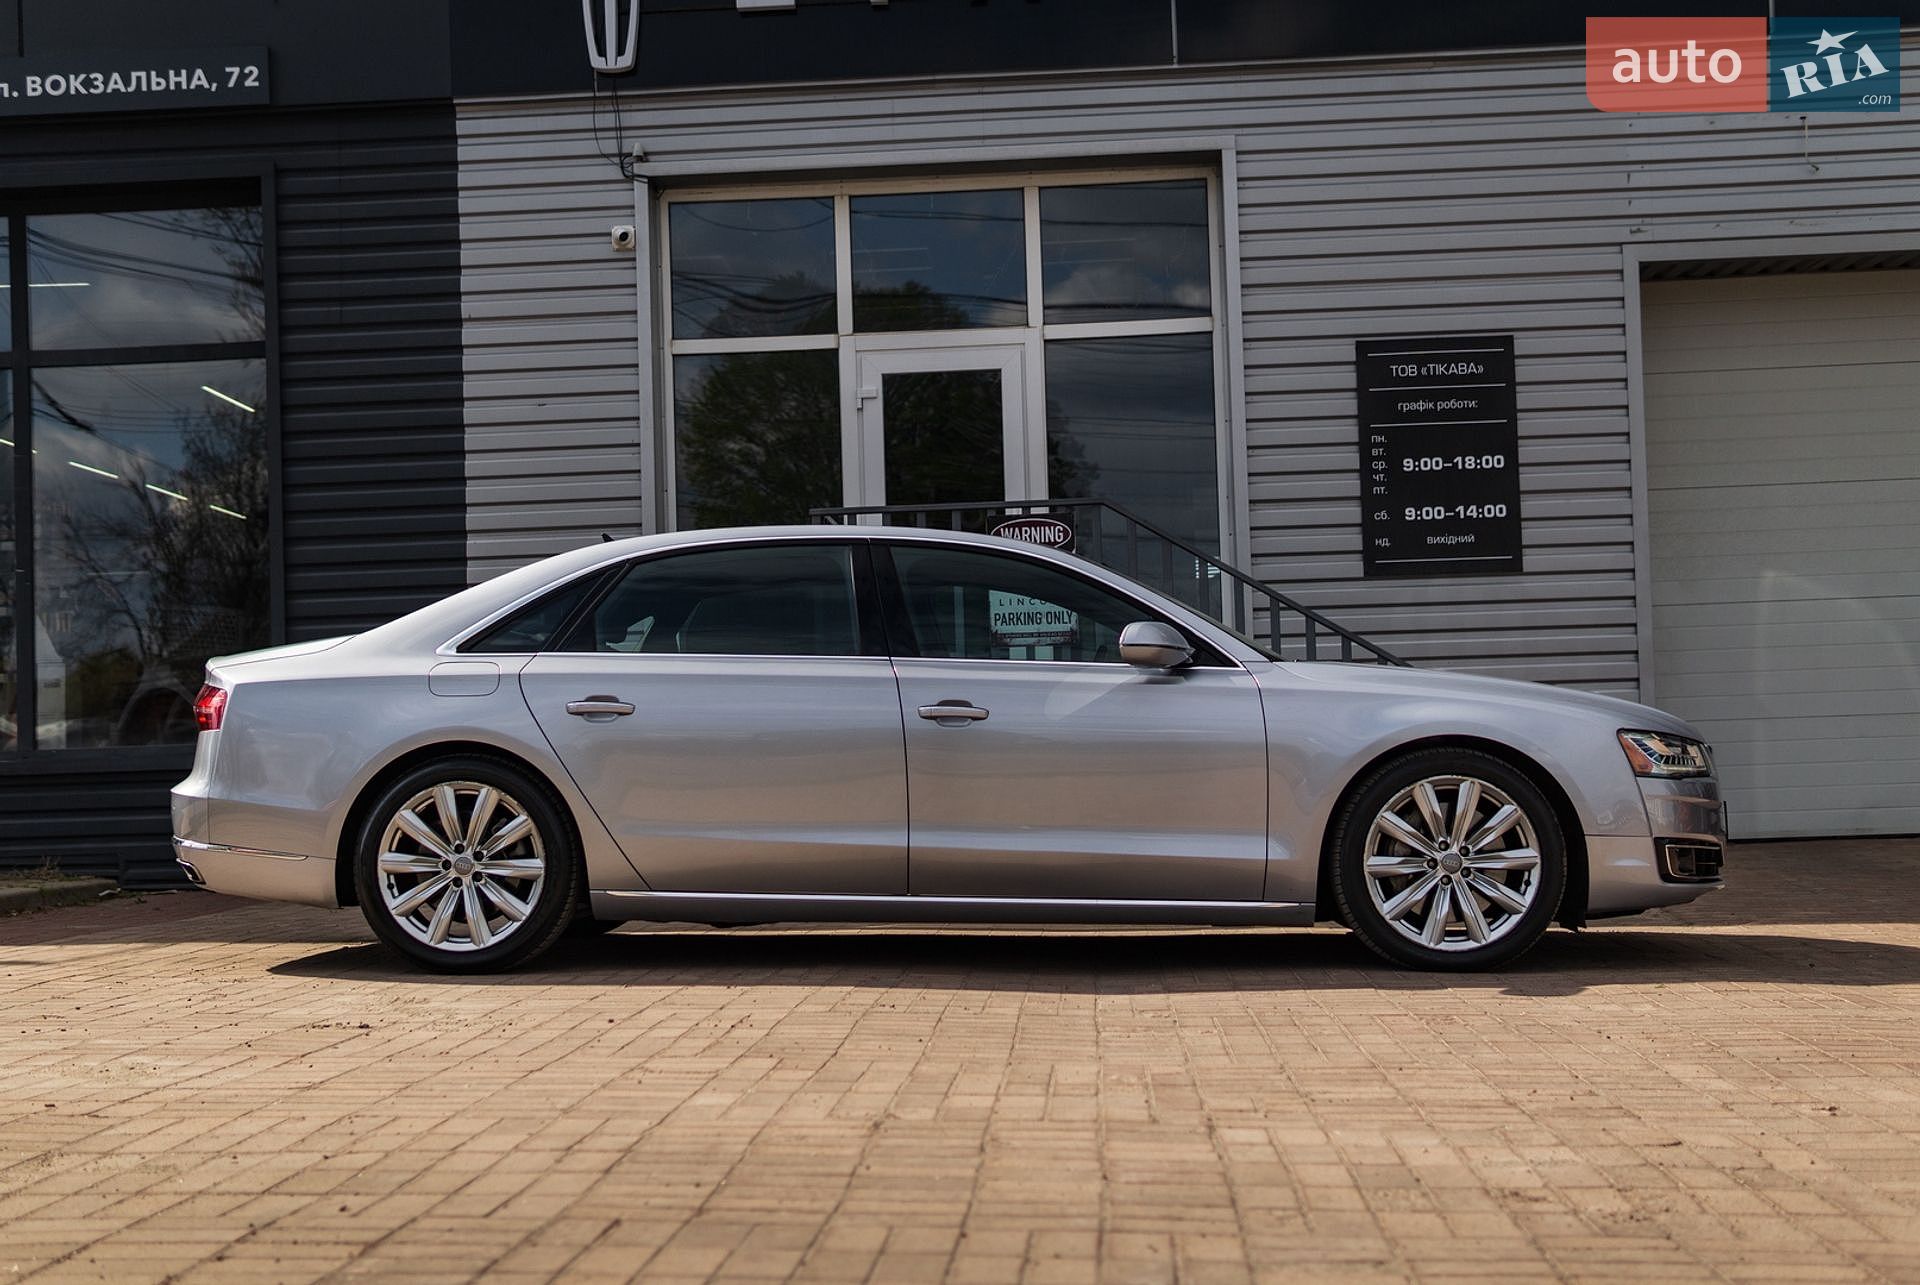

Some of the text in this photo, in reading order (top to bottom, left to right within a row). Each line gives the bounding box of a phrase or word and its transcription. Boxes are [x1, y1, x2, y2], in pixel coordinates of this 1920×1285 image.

[25, 68, 218, 97] ВОКЗАЛЬНА,
[225, 65, 260, 88] 72
[1389, 364, 1418, 378] ТОВ
[1397, 398, 1478, 413] графік роботи:
[1371, 434, 1388, 444] пн.
[1371, 447, 1387, 456] вт.
[1371, 460, 1388, 471] ср.
[1372, 473, 1388, 482] чт.
[1372, 486, 1388, 495] пт.
[1374, 510, 1391, 521] сб.
[1000, 525, 1064, 544] WARNING
[1375, 533, 1475, 547] нд. вихідний
[994, 609, 1073, 627] PARKING ONLY
